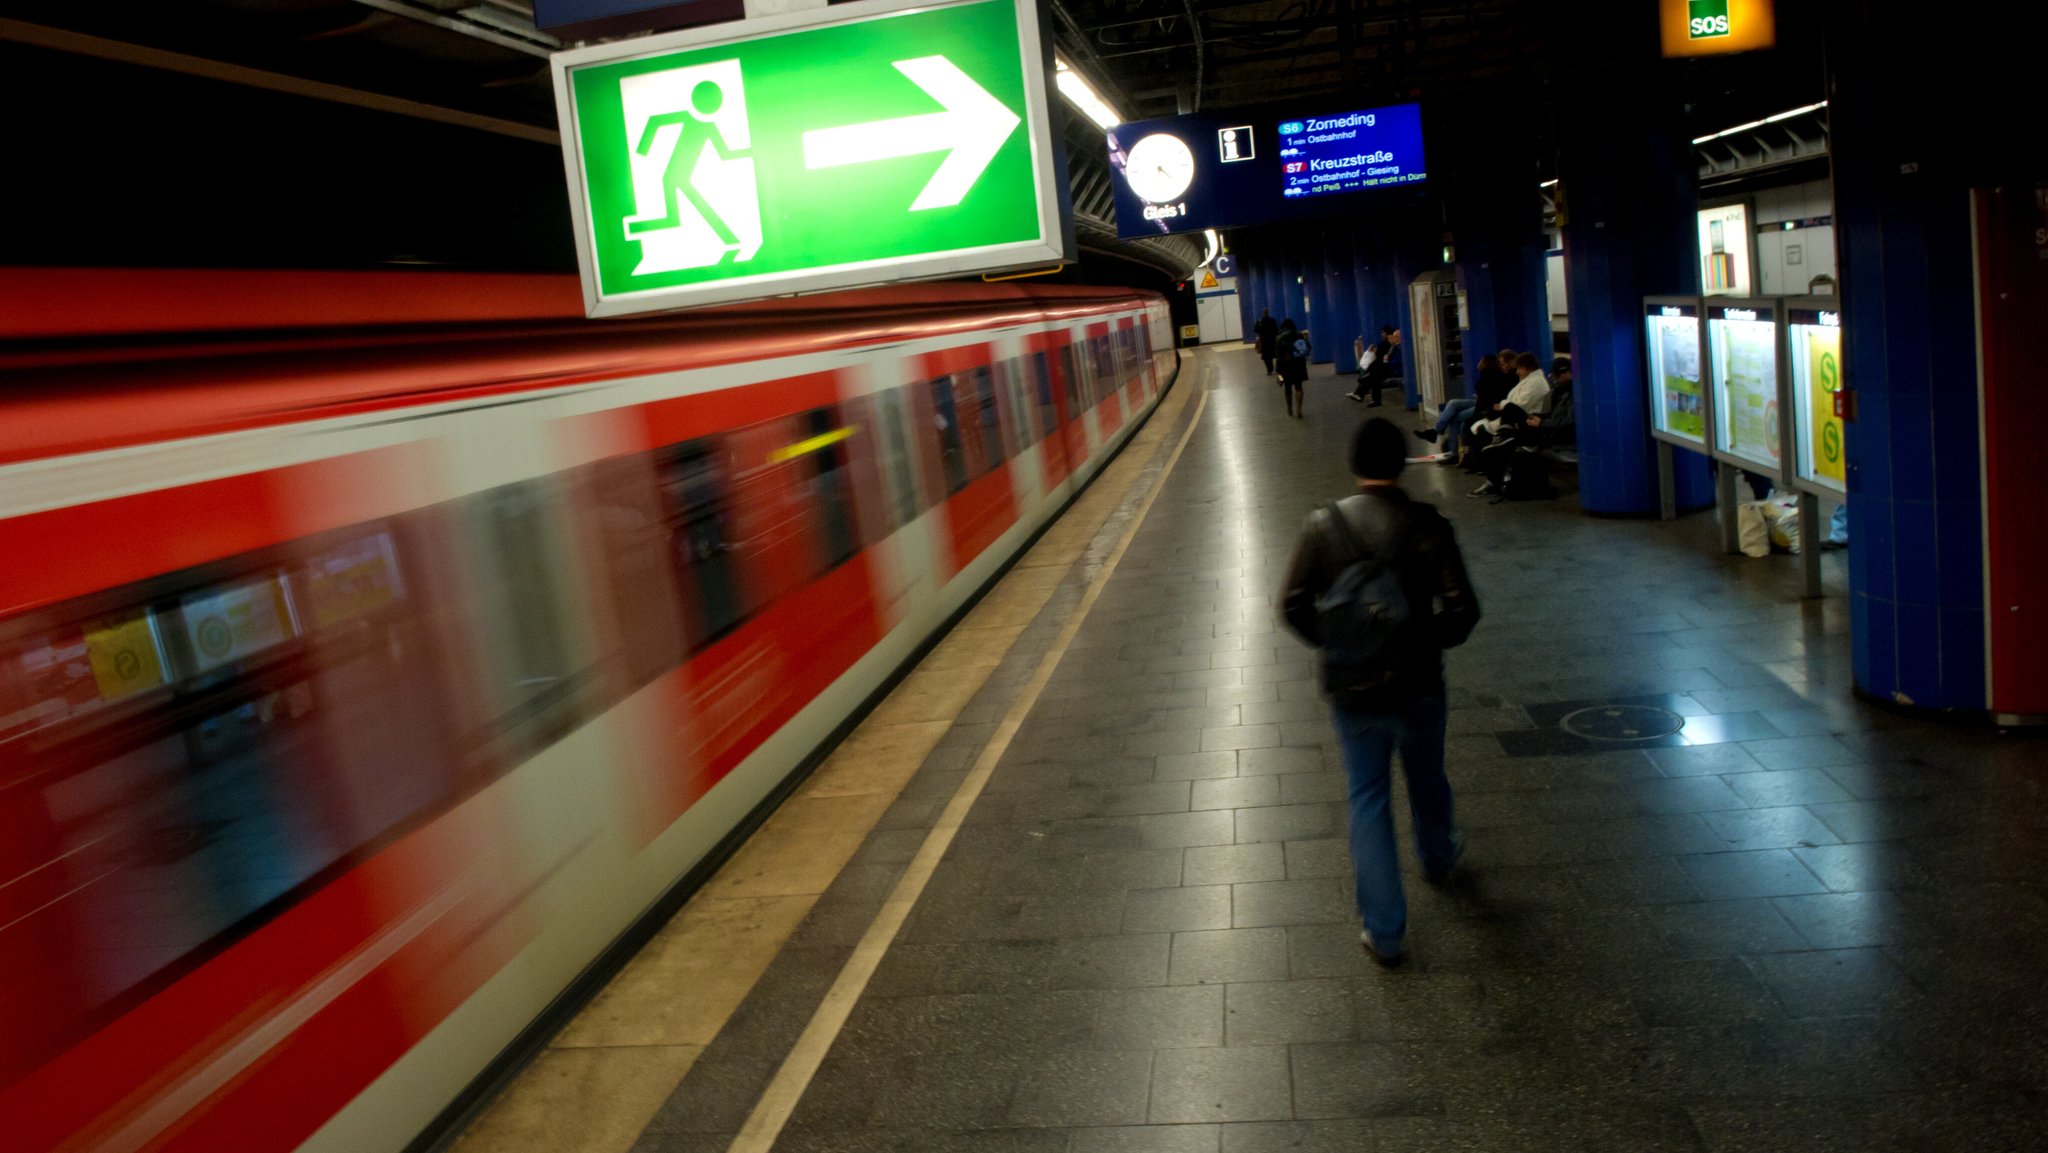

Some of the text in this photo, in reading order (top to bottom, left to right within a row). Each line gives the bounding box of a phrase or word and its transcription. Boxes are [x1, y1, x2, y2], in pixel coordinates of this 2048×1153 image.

[1691, 15, 1728, 35] SOS
[1283, 114, 1375, 134] S6 Zorneding
[1287, 138, 1292, 146] 1
[1307, 130, 1357, 144] Ostbahnhof
[1287, 150, 1393, 173] S7 Kreuzstraße
[1290, 177, 1297, 186] 2
[1311, 169, 1360, 183] Ostbahnhof
[1367, 165, 1399, 176] Giesing
[1380, 175, 1398, 184] nicht
[1399, 174, 1406, 182] in
[1143, 202, 1186, 220] Gleis 1
[1216, 256, 1230, 274] C
